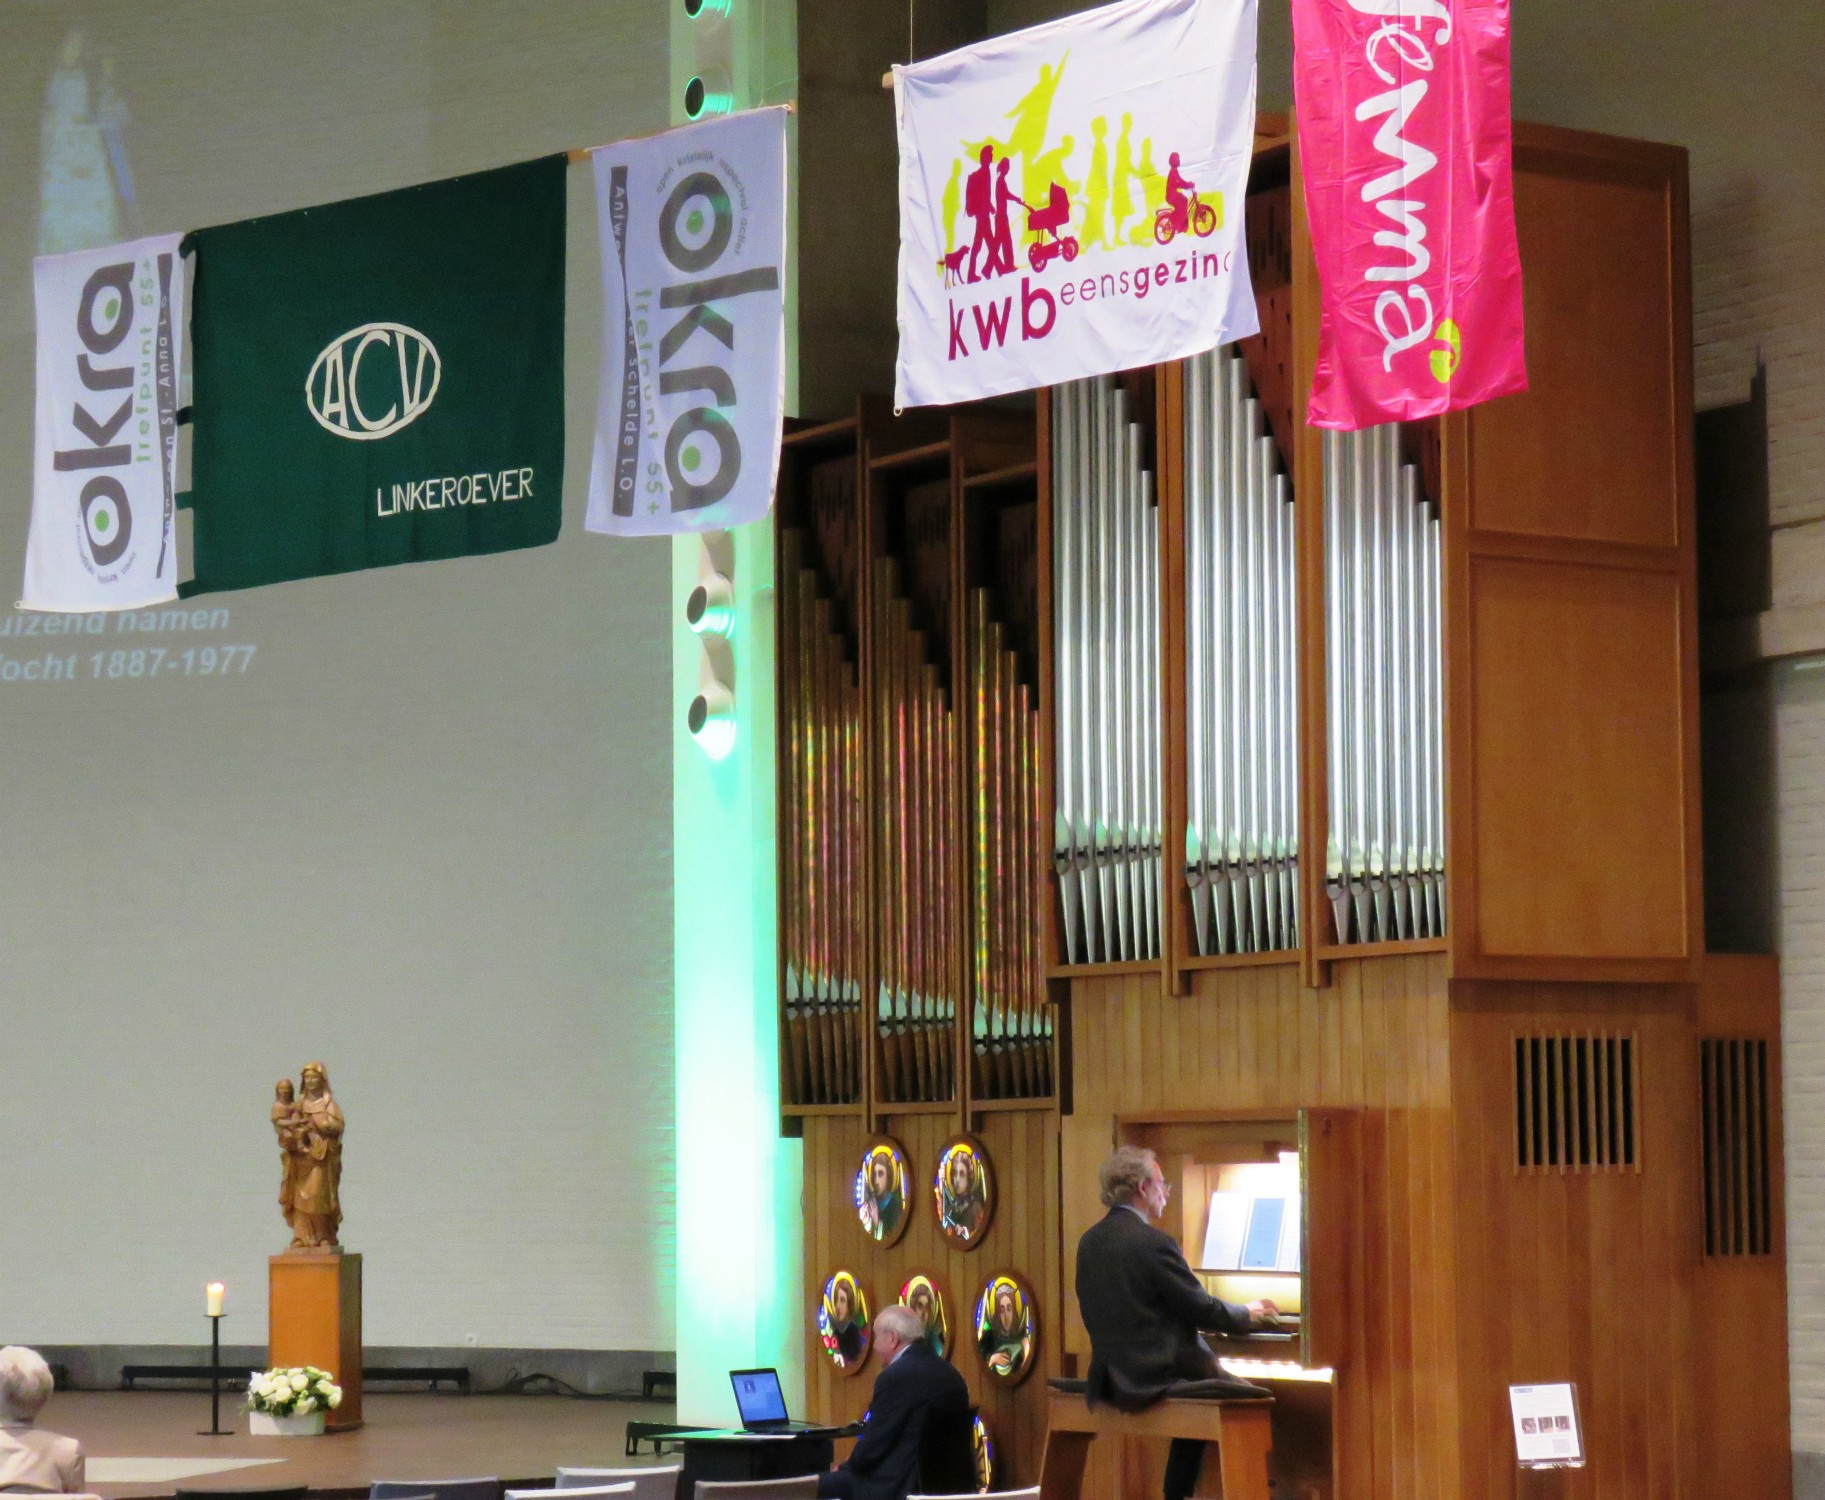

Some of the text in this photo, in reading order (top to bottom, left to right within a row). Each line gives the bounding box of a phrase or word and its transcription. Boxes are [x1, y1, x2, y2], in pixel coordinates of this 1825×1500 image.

[659, 172, 780, 513] okra
[947, 276, 1057, 361] kwb
[53, 261, 136, 567] okra
[134, 324, 152, 463] trefpunt
[321, 329, 428, 431] ACV
[633, 287, 664, 515] trefpunt 55+
[376, 467, 534, 517] LINKEROEVER
[0, 645, 257, 682] ocht 1887-1977
[116, 607, 230, 633] namen
